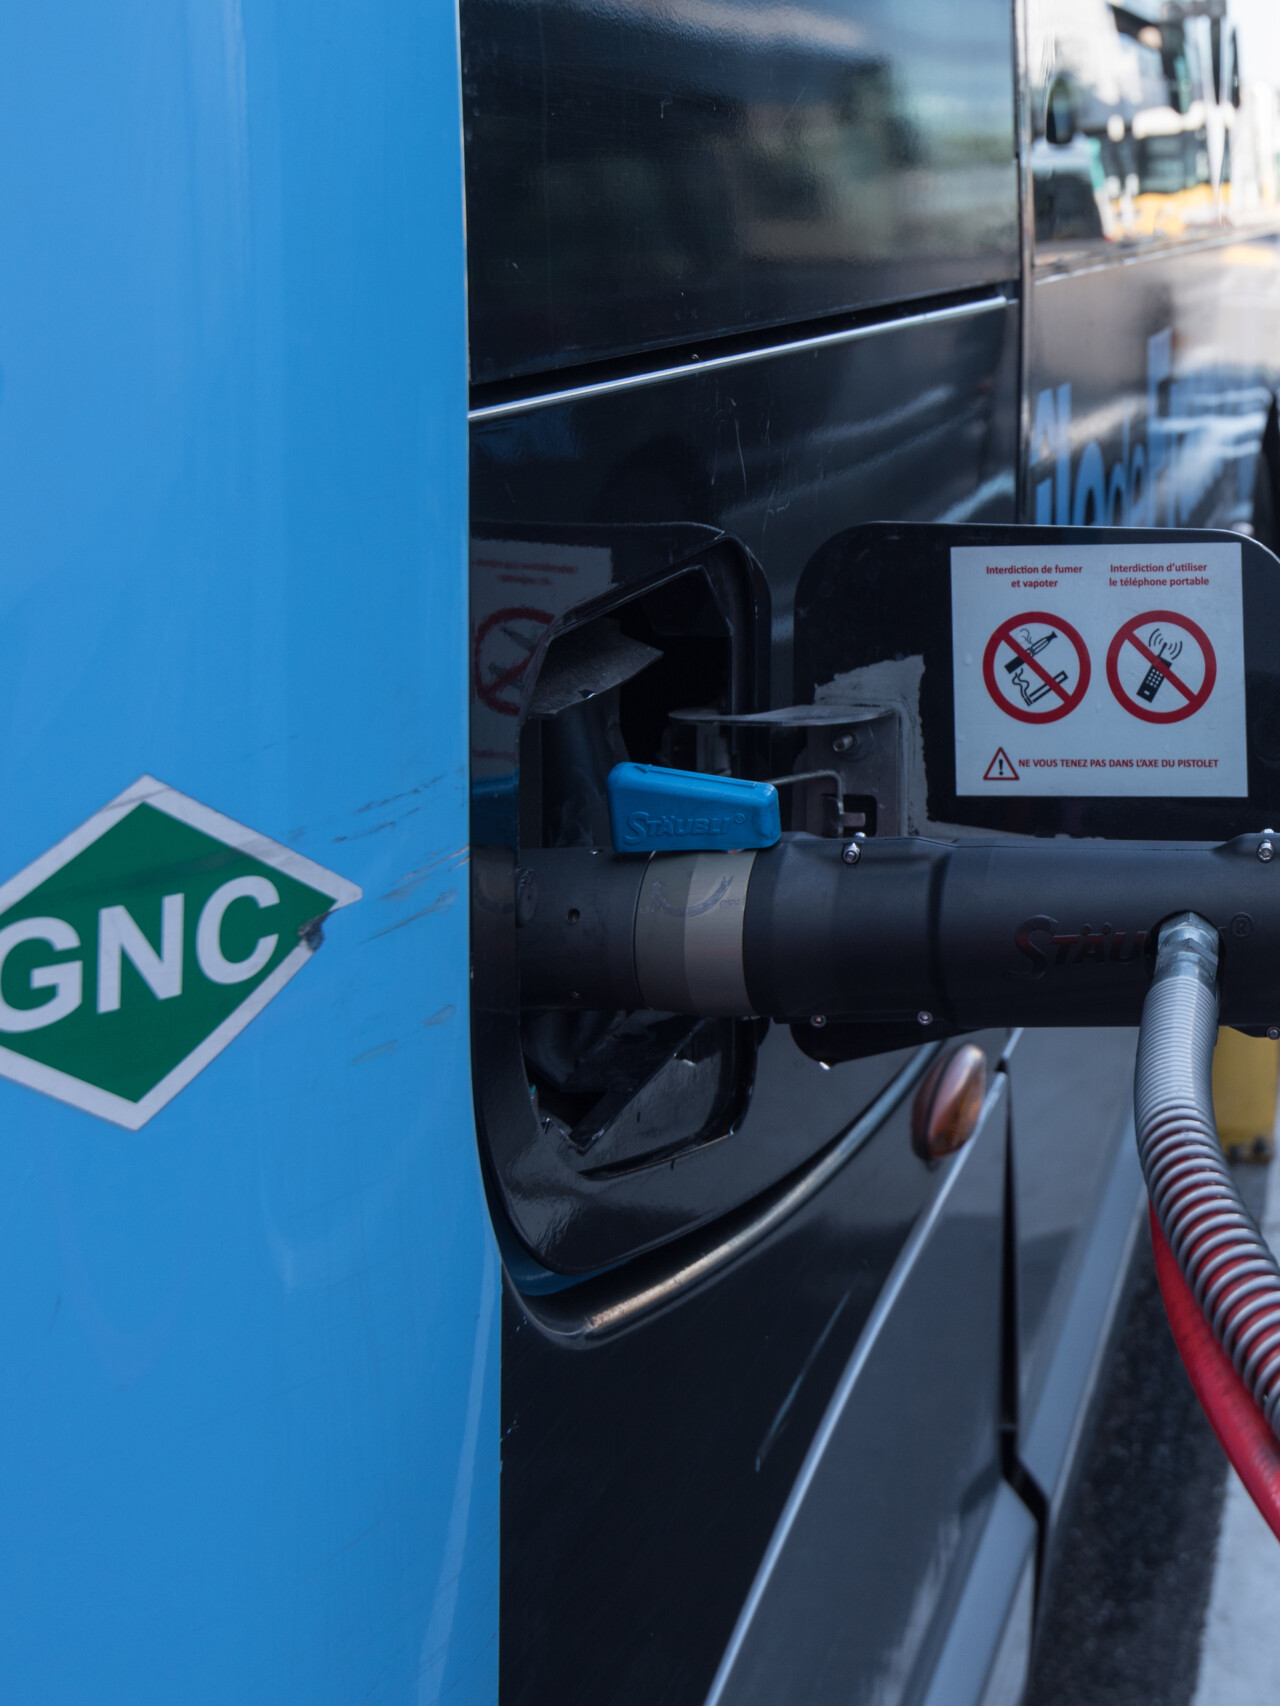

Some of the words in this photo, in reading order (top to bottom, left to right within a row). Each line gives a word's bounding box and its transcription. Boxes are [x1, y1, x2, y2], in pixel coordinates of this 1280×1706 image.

[986, 565, 1039, 574] Interdiction
[1041, 565, 1052, 573] de
[1054, 564, 1083, 573] fumer
[1110, 563, 1164, 572] Interdiction
[1011, 580, 1020, 588] et
[1022, 580, 1058, 589] vapoter
[1109, 577, 1118, 586] le
[1120, 577, 1167, 588] téléphone
[1169, 576, 1210, 587] portable
[1018, 759, 1031, 768] NE
[1033, 759, 1058, 768] VOUS
[1060, 759, 1088, 768] TENEZ
[1090, 759, 1107, 768] PAS
[1109, 759, 1134, 768] DANS
[1161, 759, 1175, 768] DU
[1178, 759, 1220, 768] PISTOLET
[0, 875, 281, 1034] GNC
